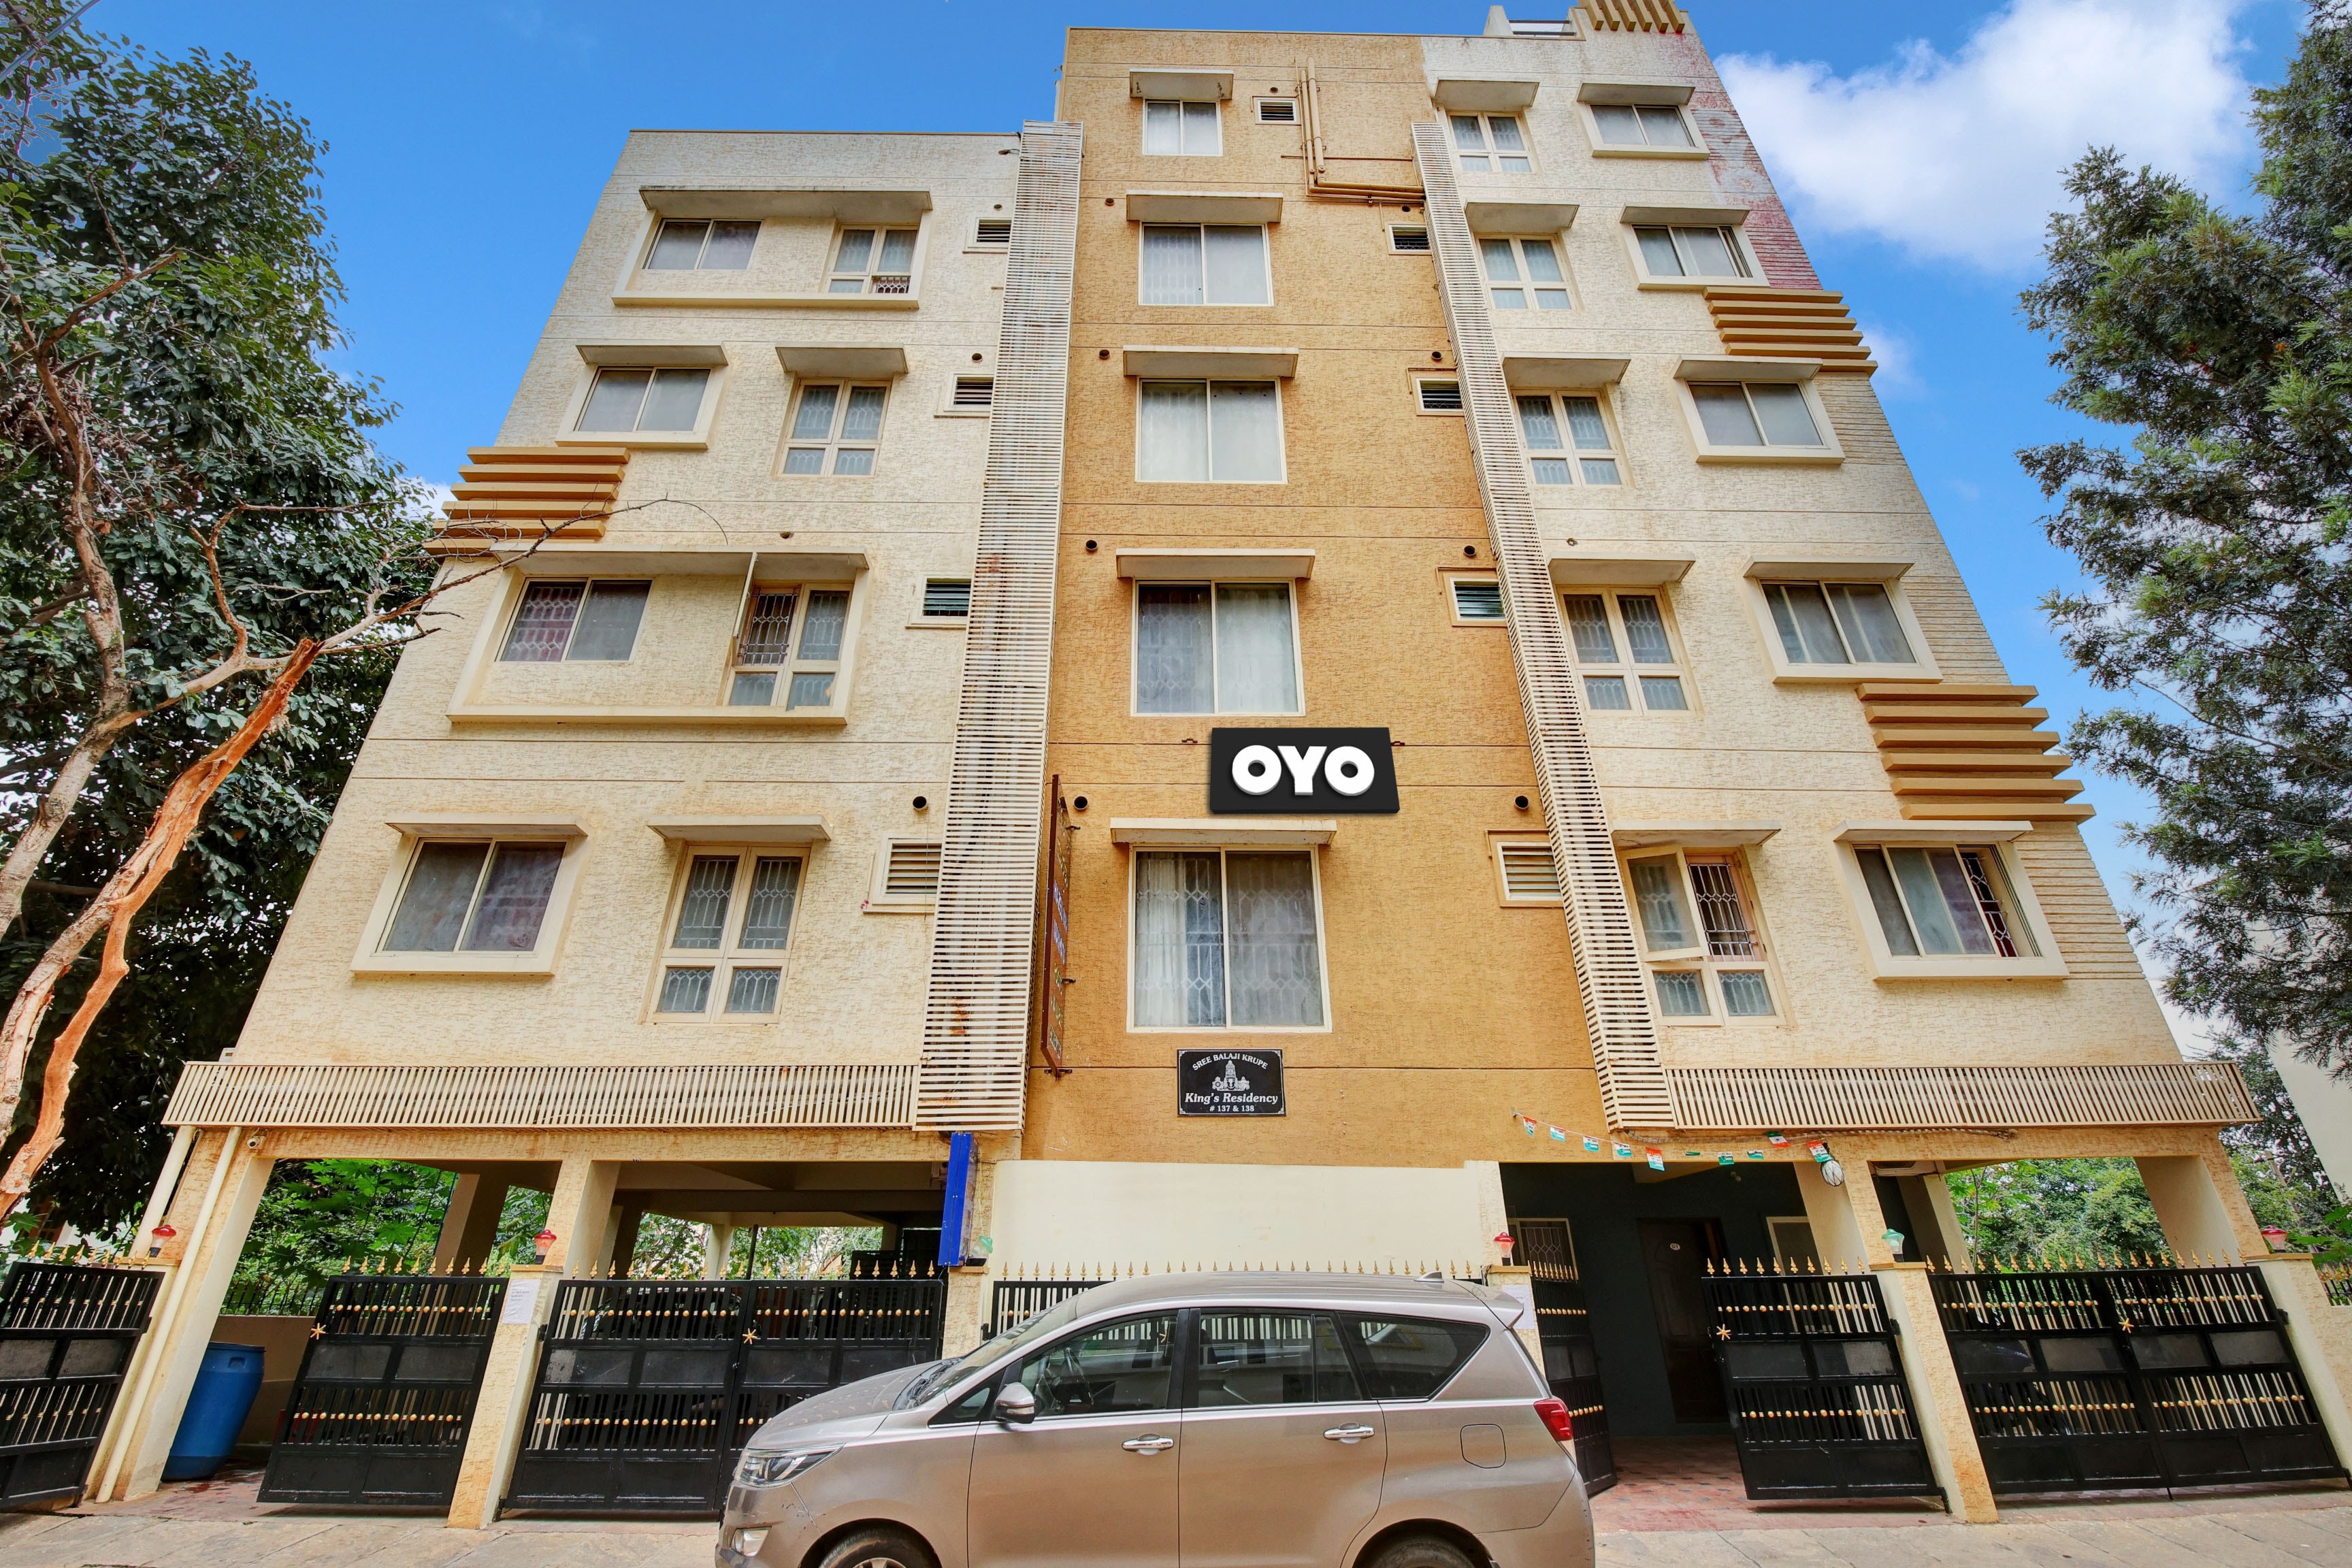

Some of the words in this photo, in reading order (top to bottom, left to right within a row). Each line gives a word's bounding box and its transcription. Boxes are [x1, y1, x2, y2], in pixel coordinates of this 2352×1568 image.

[1232, 745, 1375, 796] OYO
[1192, 1056, 1212, 1071] SREE
[1213, 1053, 1240, 1061] BALAJI
[1242, 1054, 1269, 1070] KRUPE
[1185, 1092, 1220, 1105] King's
[1222, 1092, 1278, 1105] Residency
